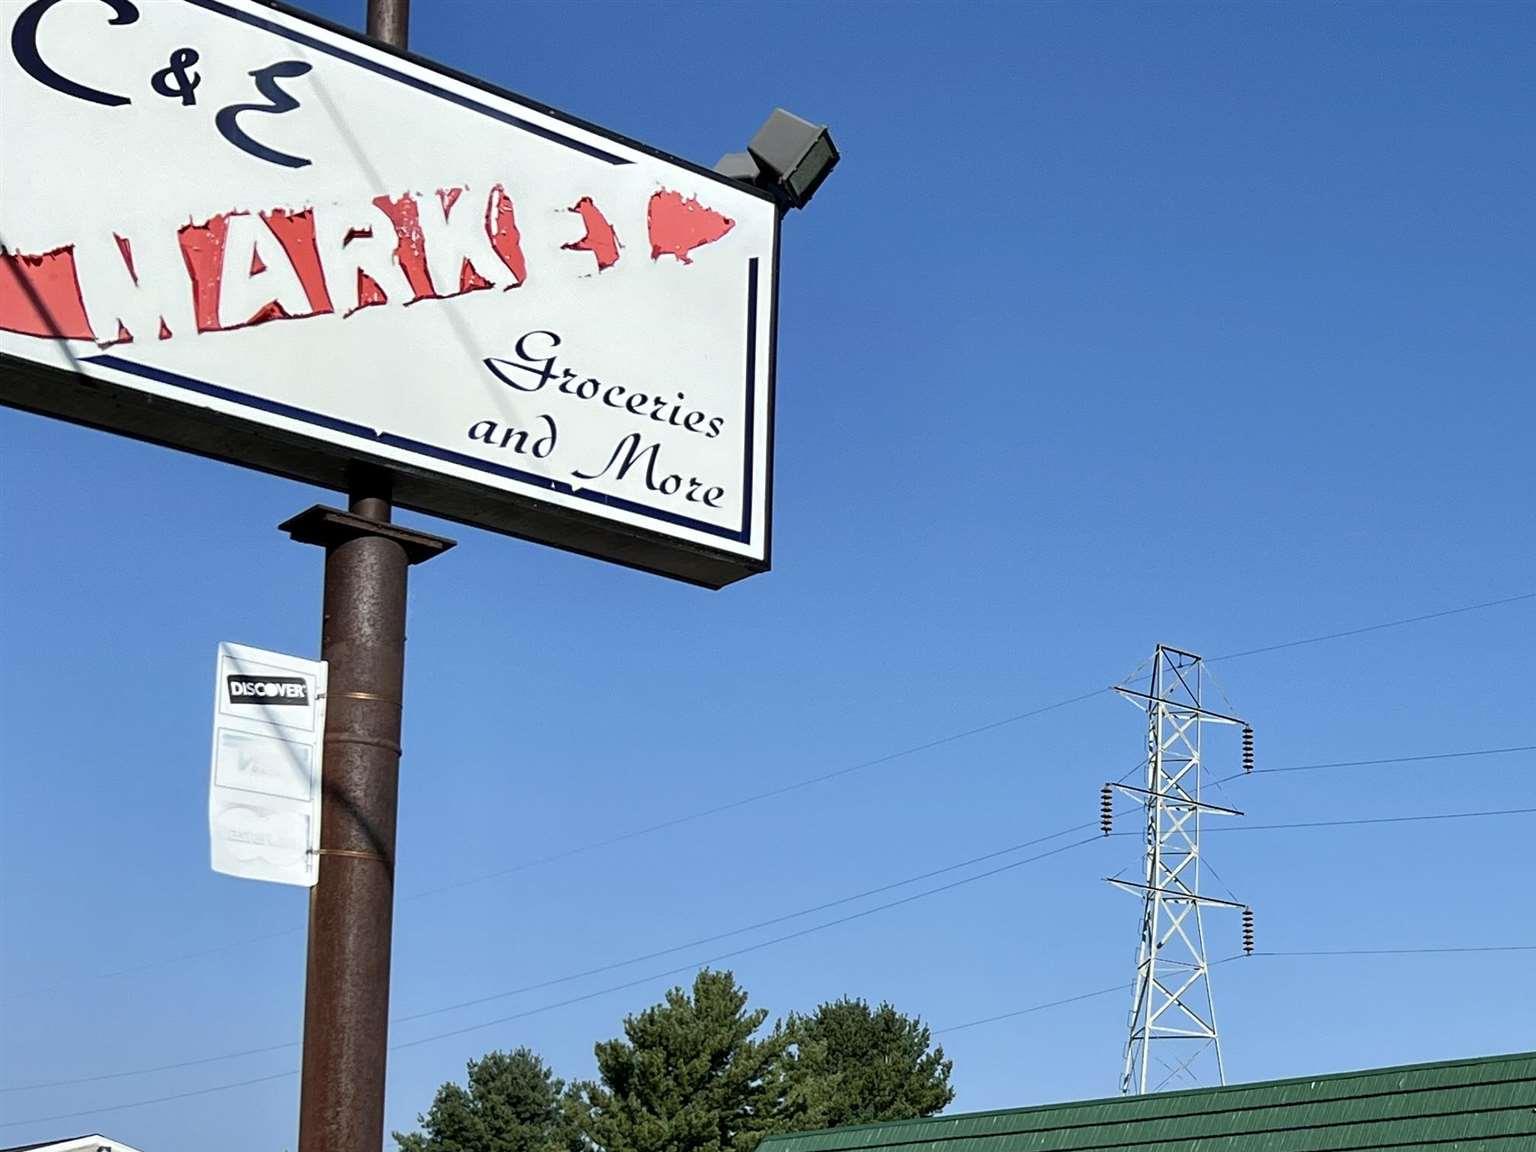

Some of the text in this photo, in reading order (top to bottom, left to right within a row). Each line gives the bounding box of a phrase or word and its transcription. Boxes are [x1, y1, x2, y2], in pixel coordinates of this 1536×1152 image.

[11, 0, 313, 168] C & E
[483, 330, 725, 440] Groceries
[468, 414, 725, 510] and More
[230, 680, 307, 698] DISCOVER
